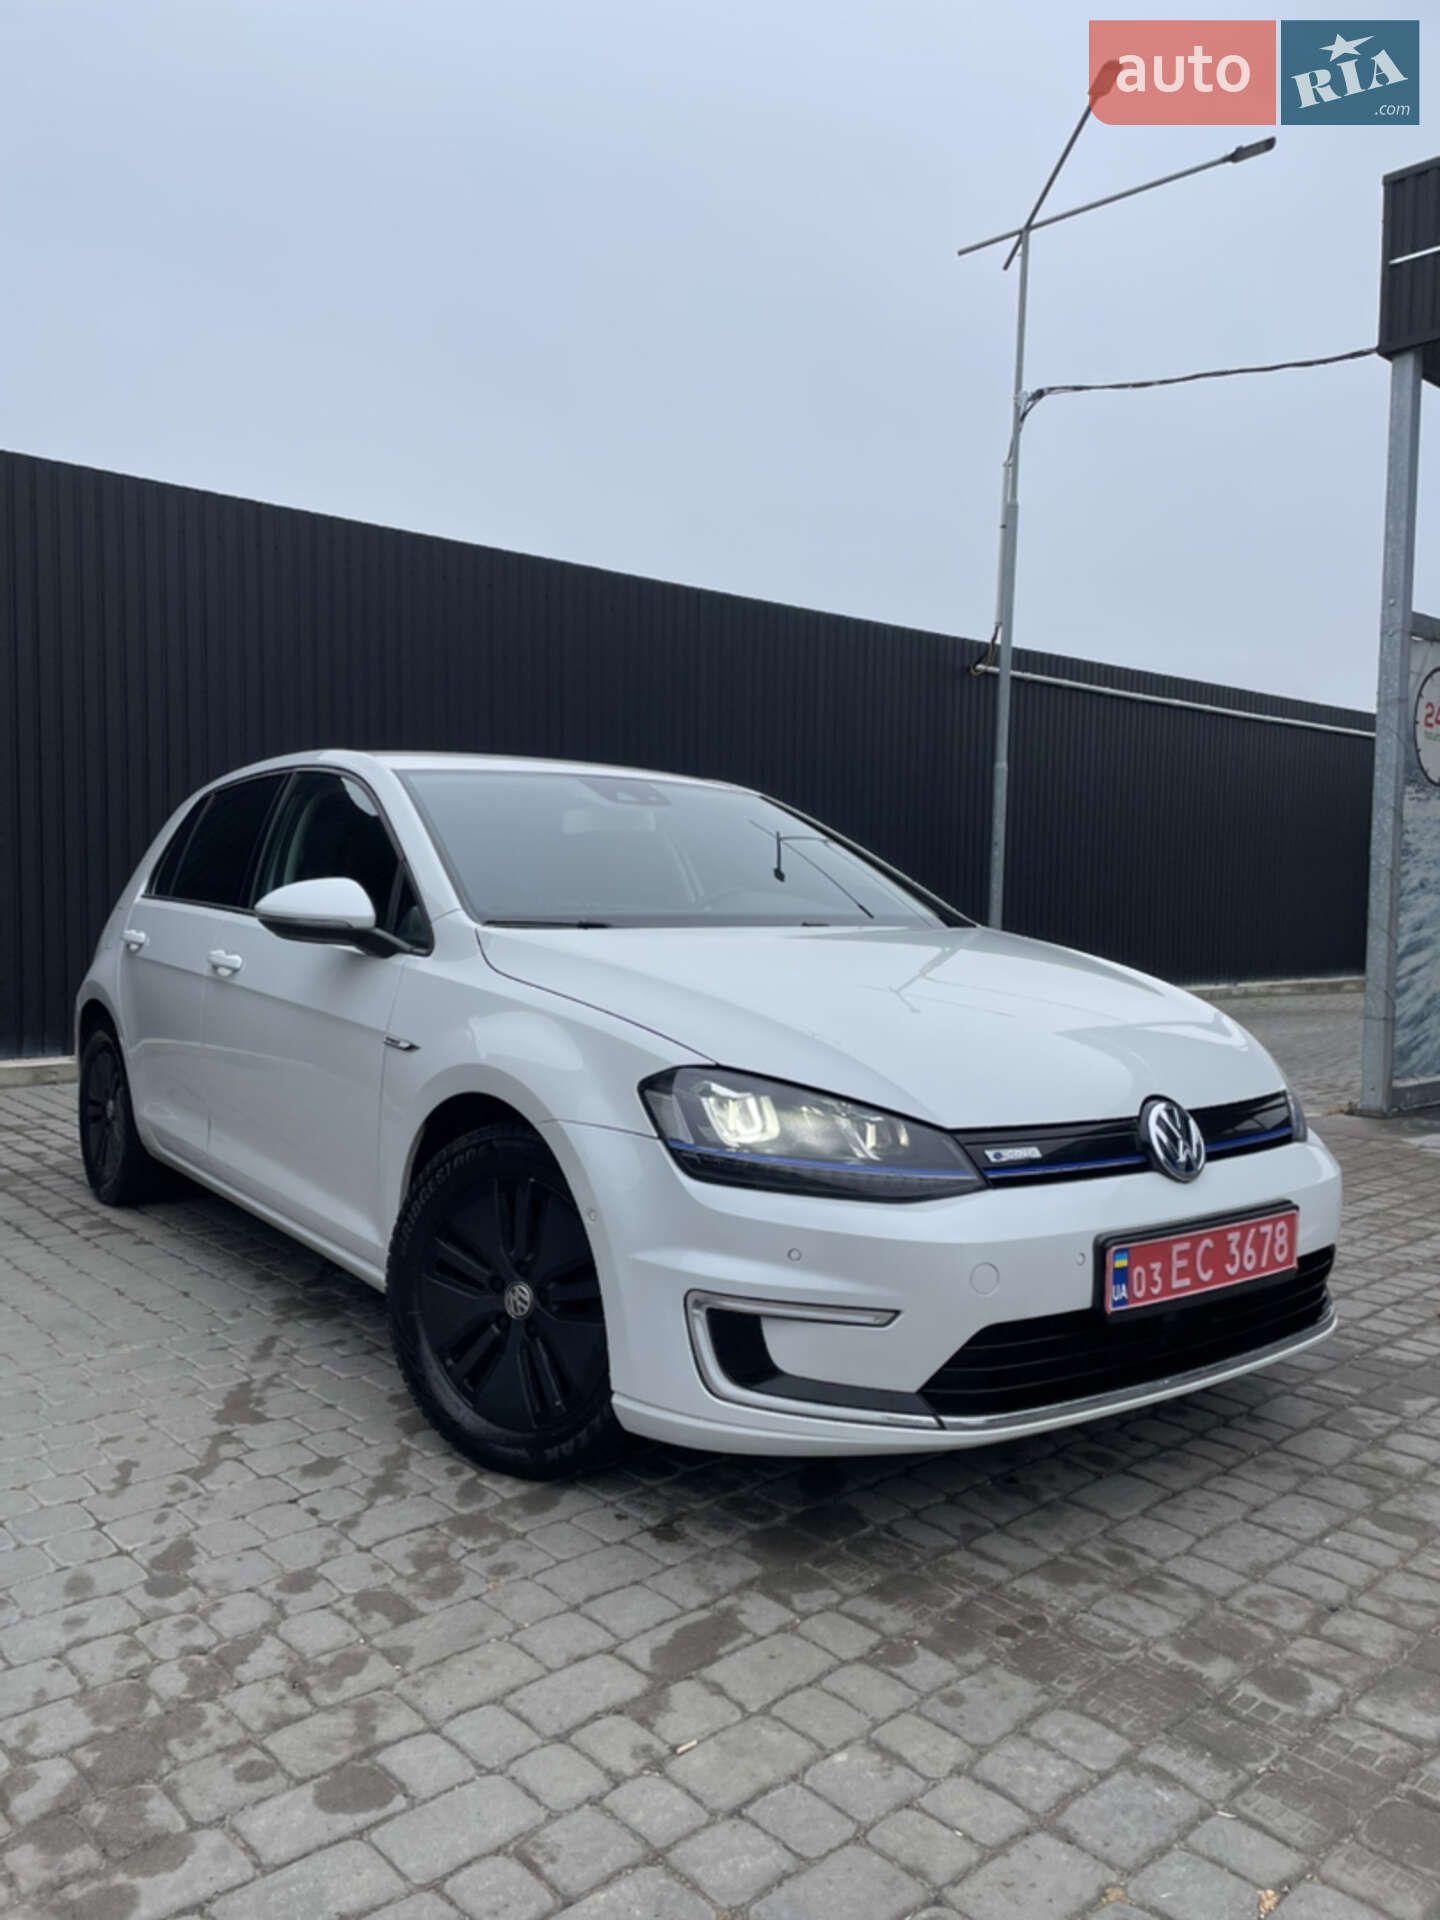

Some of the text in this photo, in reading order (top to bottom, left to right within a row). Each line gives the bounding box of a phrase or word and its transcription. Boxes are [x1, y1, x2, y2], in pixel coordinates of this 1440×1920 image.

[1133, 1221, 1289, 1298] 03 EC 3678
[1112, 1284, 1128, 1300] UA
